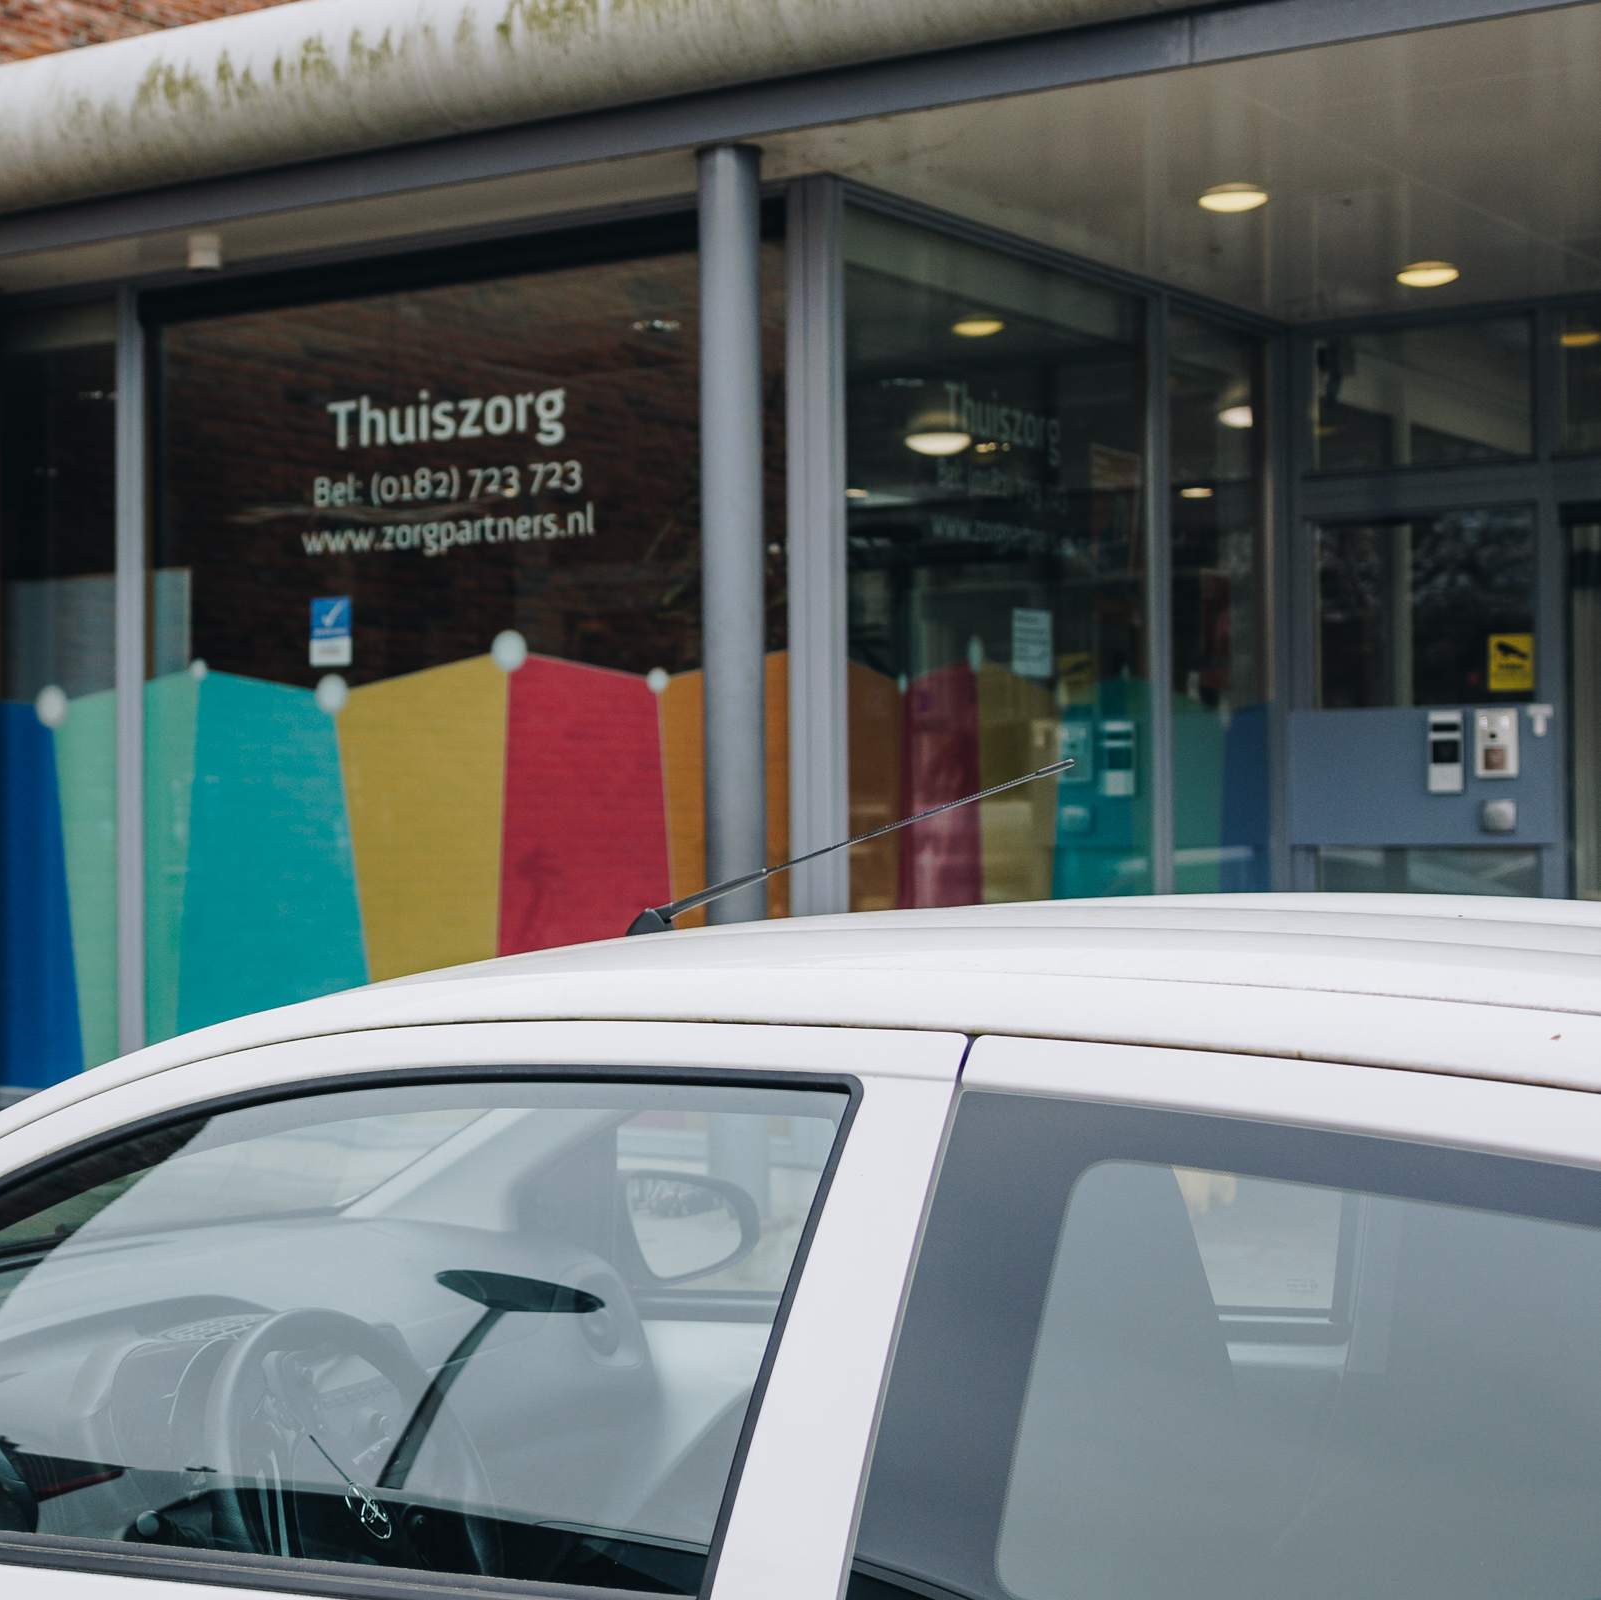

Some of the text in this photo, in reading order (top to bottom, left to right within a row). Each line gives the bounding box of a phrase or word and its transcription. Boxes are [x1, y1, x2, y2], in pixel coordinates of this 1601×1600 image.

[326, 387, 567, 450] Thuiszorg
[313, 458, 583, 508] Bel: (0182) 723 723
[301, 500, 596, 558] www.zorgpartners.nl
